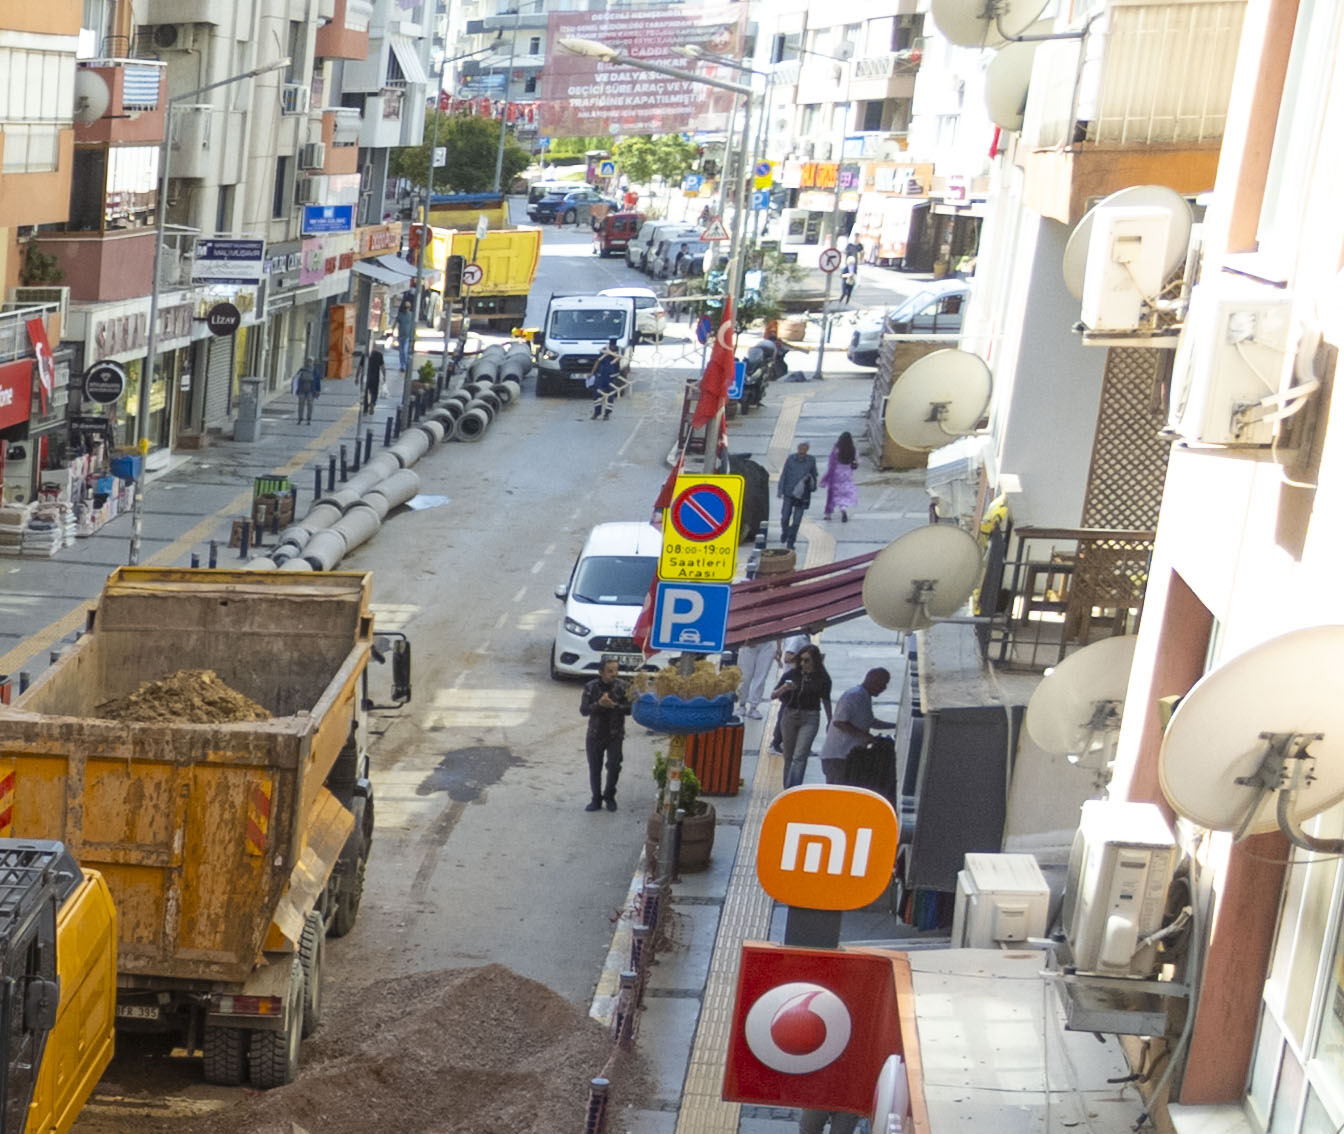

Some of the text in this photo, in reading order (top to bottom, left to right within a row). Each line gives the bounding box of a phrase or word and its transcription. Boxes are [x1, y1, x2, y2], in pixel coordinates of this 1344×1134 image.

[670, 557, 726, 568] Saatleri
[678, 568, 716, 578] Arası
[659, 588, 705, 643] P
